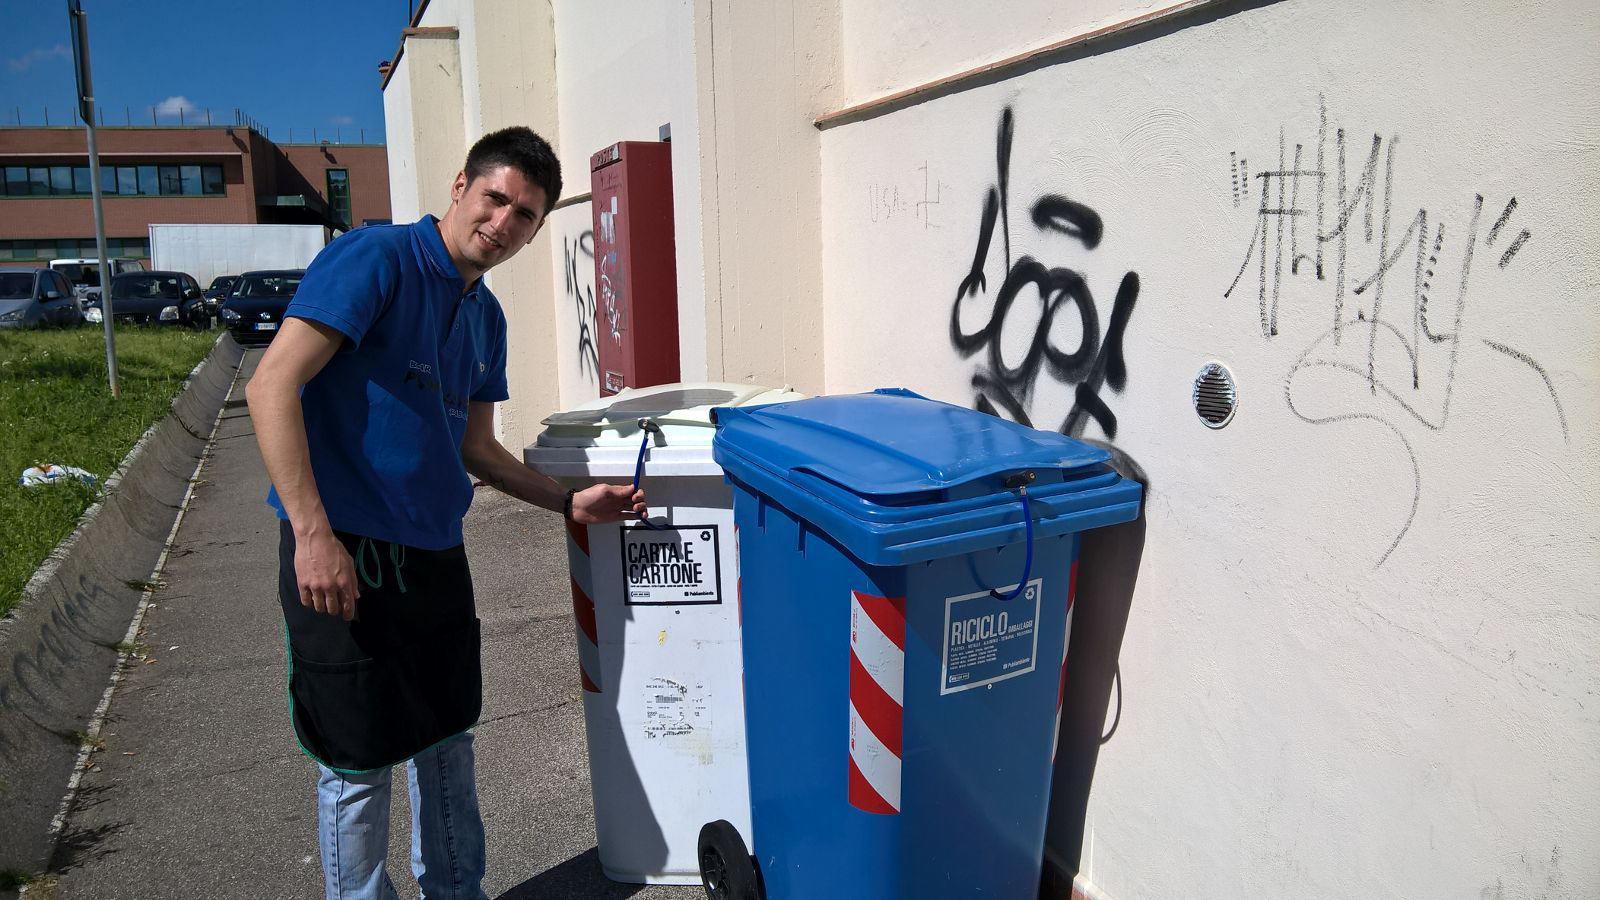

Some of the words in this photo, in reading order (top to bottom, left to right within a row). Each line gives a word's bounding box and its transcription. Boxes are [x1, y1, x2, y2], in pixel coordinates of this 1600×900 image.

[627, 542, 681, 563] CARTA
[683, 542, 694, 563] E
[629, 563, 703, 584] CARTONE
[951, 611, 1009, 646] RICICLO
